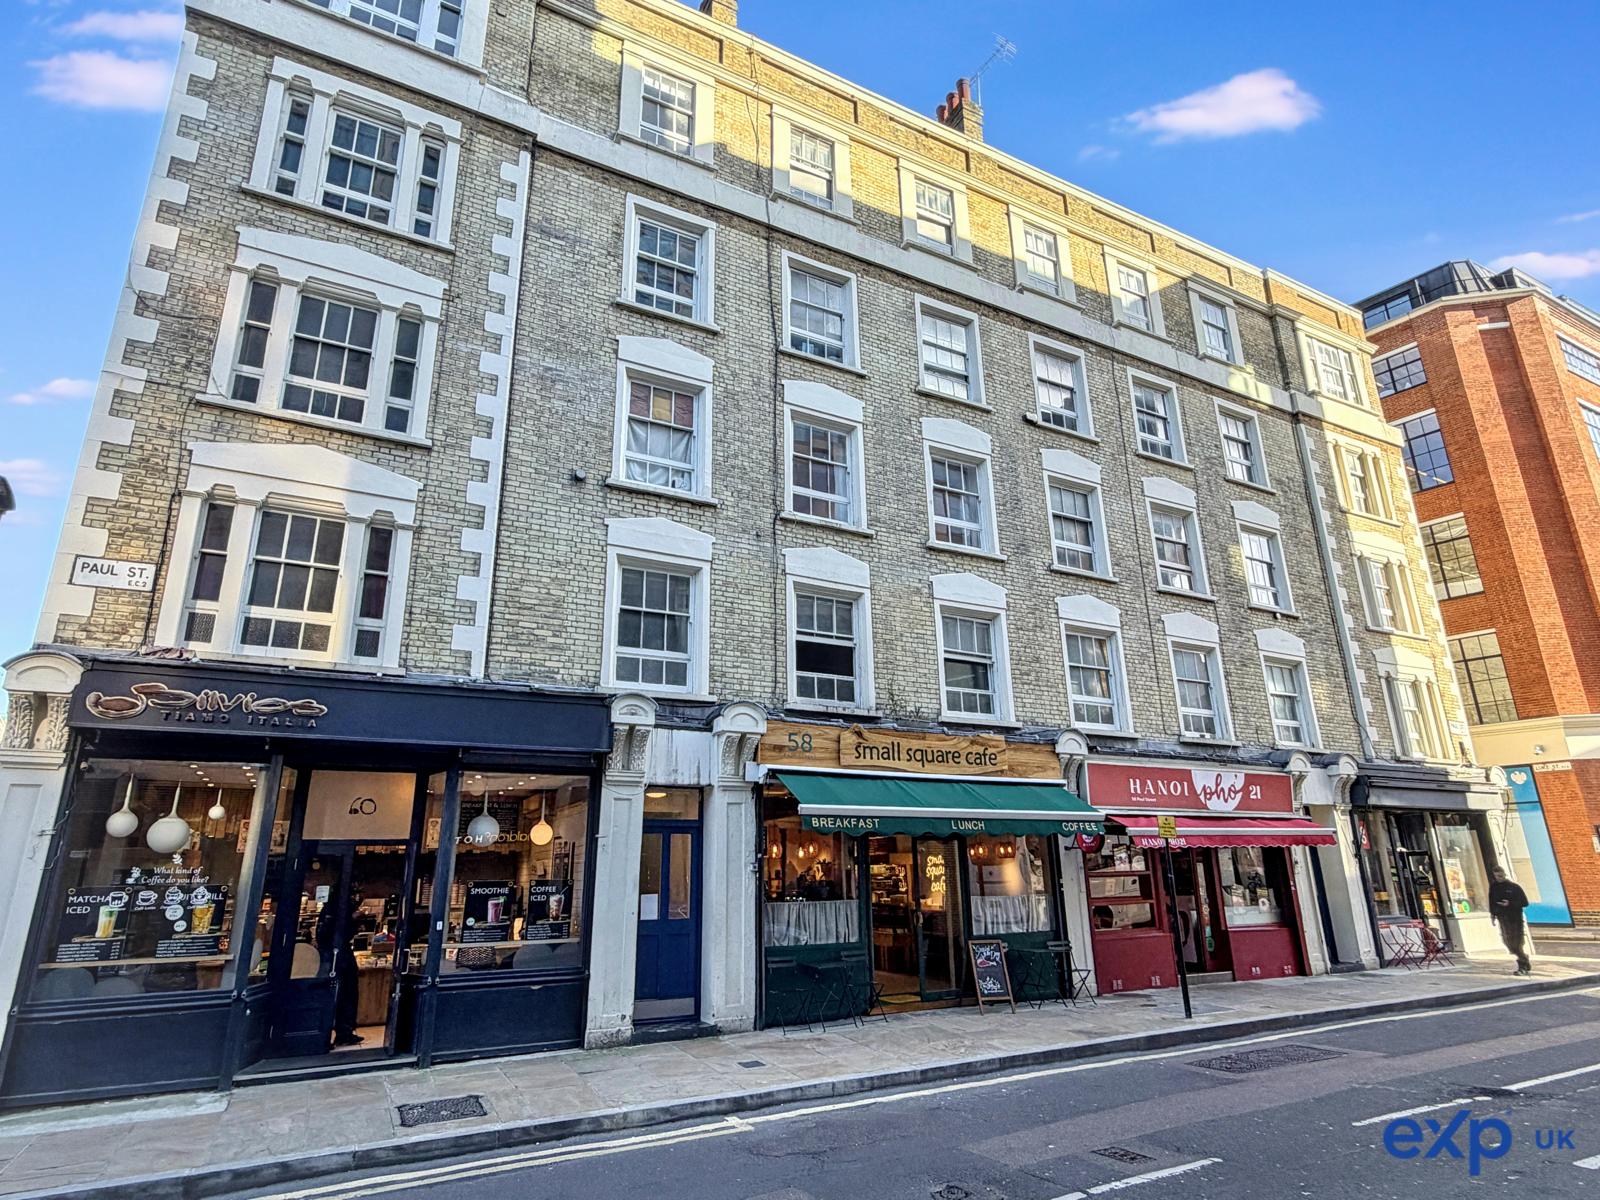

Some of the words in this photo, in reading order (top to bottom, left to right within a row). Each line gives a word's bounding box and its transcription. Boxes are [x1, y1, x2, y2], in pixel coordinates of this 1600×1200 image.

[80, 562, 118, 576] PAUL
[127, 566, 149, 579] ST.
[160, 709, 230, 723] TIAMO
[787, 732, 813, 753] 58
[854, 741, 901, 761] small
[906, 747, 961, 768] square
[965, 747, 998, 766] cafe
[1129, 778, 1189, 796] HANOI
[1249, 784, 1261, 800] 21
[811, 817, 880, 829] BREAKFAST
[951, 819, 985, 830] LUNCH
[1061, 822, 1098, 831] COFFEE
[153, 866, 174, 874] What
[175, 866, 192, 874] kind
[192, 866, 204, 876] of
[141, 876, 165, 885] Coffee
[165, 875, 176, 883] do
[176, 877, 190, 885] you
[191, 875, 210, 884] like?
[470, 887, 510, 895] SMOOTHIE
[68, 895, 110, 904] MATCHA
[530, 894, 547, 902] ICED
[65, 906, 91, 914] ICED
